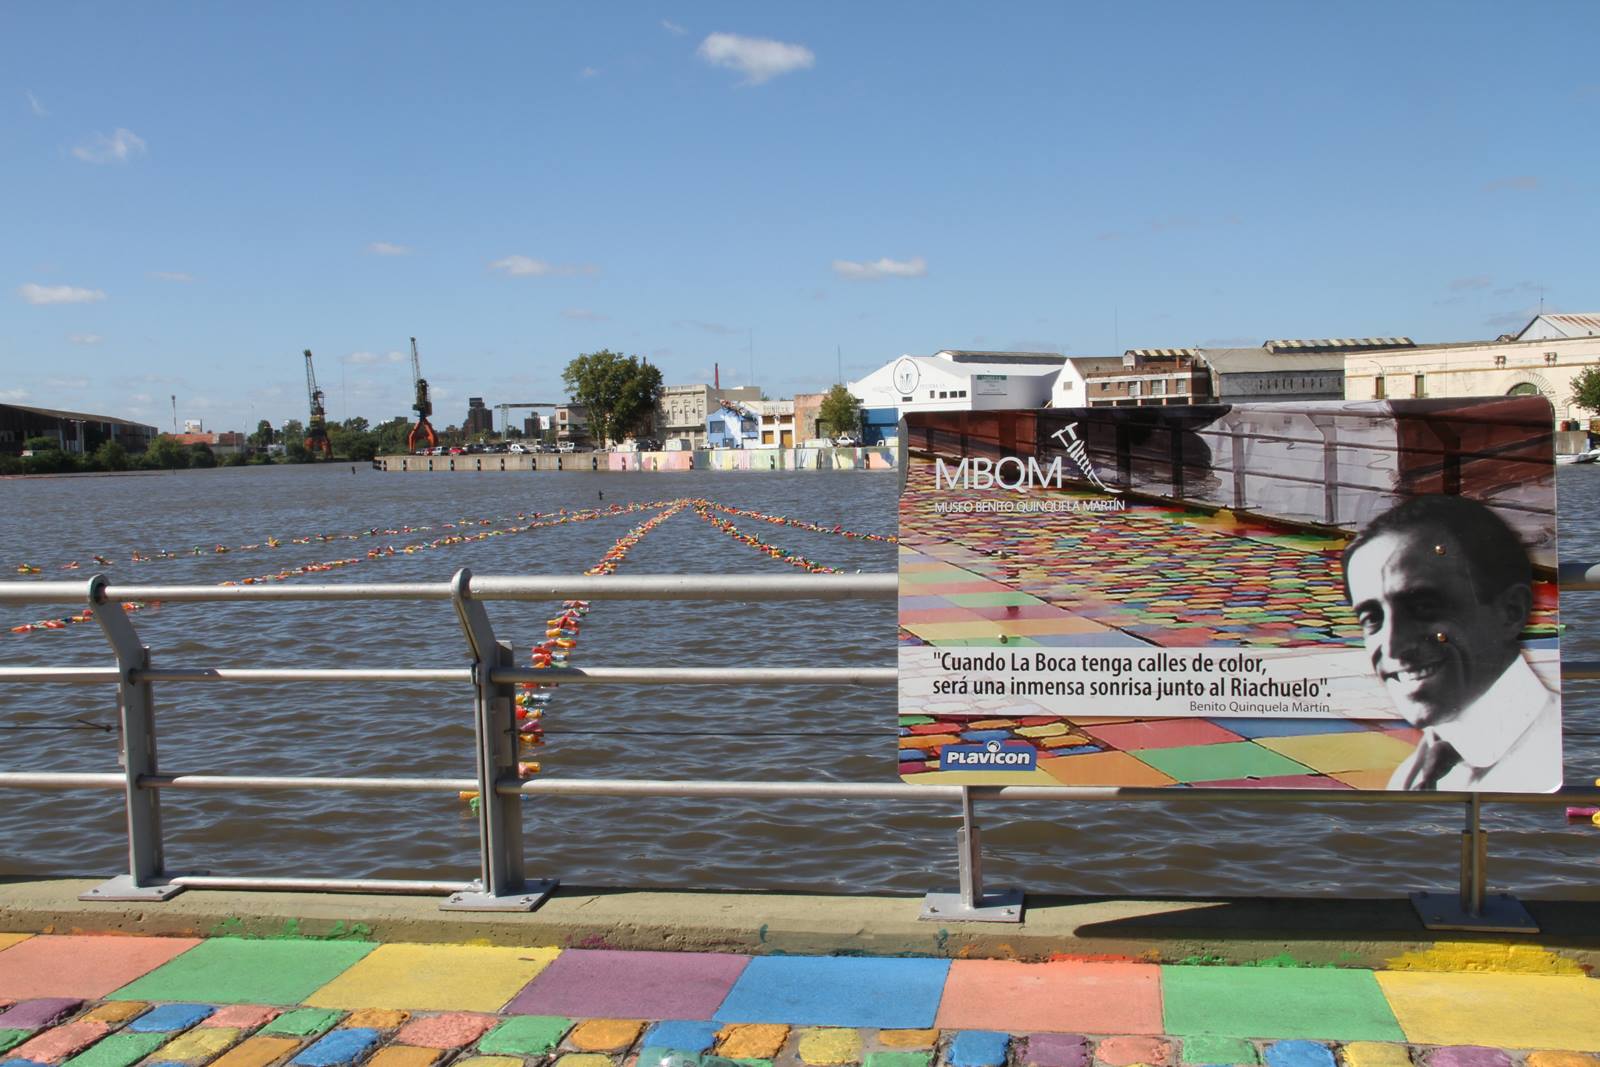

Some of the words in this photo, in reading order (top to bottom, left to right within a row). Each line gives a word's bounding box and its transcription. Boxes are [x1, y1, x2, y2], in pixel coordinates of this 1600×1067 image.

[935, 456, 1063, 493] MBQM
[934, 501, 973, 513] MUSEO
[975, 501, 1014, 513] BENITO
[1016, 500, 1081, 513] QUINQUELA
[1082, 497, 1126, 511] MARTÍN
[933, 651, 1006, 672] "Cuando
[1011, 652, 1030, 672] La
[1035, 652, 1076, 672] Boca
[1081, 655, 1132, 677] tenga
[1137, 653, 1187, 672] calles
[1192, 653, 1214, 672] de
[1219, 653, 1267, 676] color,
[933, 675, 968, 695] será
[973, 680, 1006, 695] una
[1010, 677, 1085, 696] inmensa
[1090, 677, 1152, 696] sonrisa
[1155, 677, 1205, 701] junto
[1209, 677, 1225, 696] al
[1231, 677, 1332, 698] Riachuelo".
[1189, 701, 1227, 712] Benito
[1229, 702, 1289, 714] Quinquela
